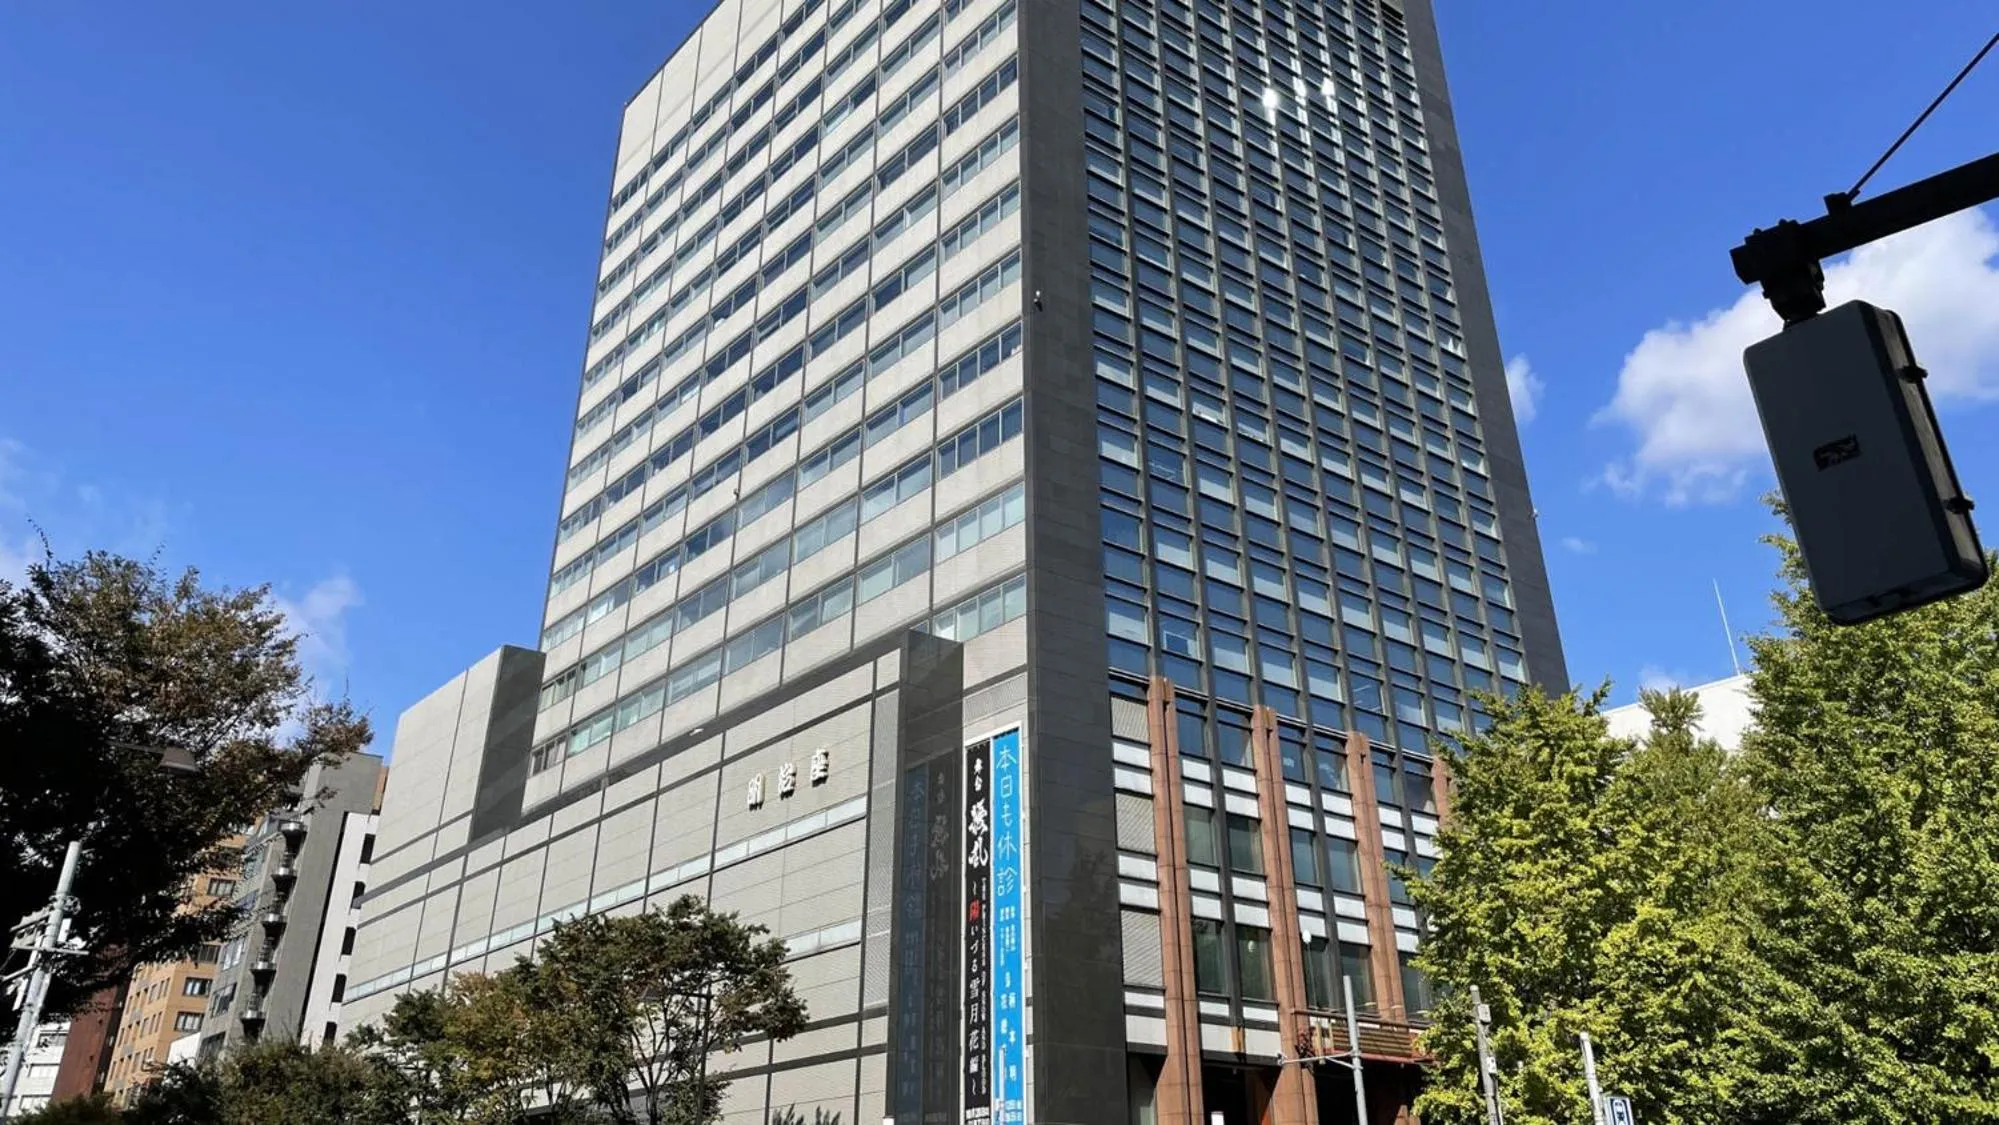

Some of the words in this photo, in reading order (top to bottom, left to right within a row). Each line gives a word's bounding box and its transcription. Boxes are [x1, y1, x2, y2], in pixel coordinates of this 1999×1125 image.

[996, 744, 1017, 897] 本日も休診
